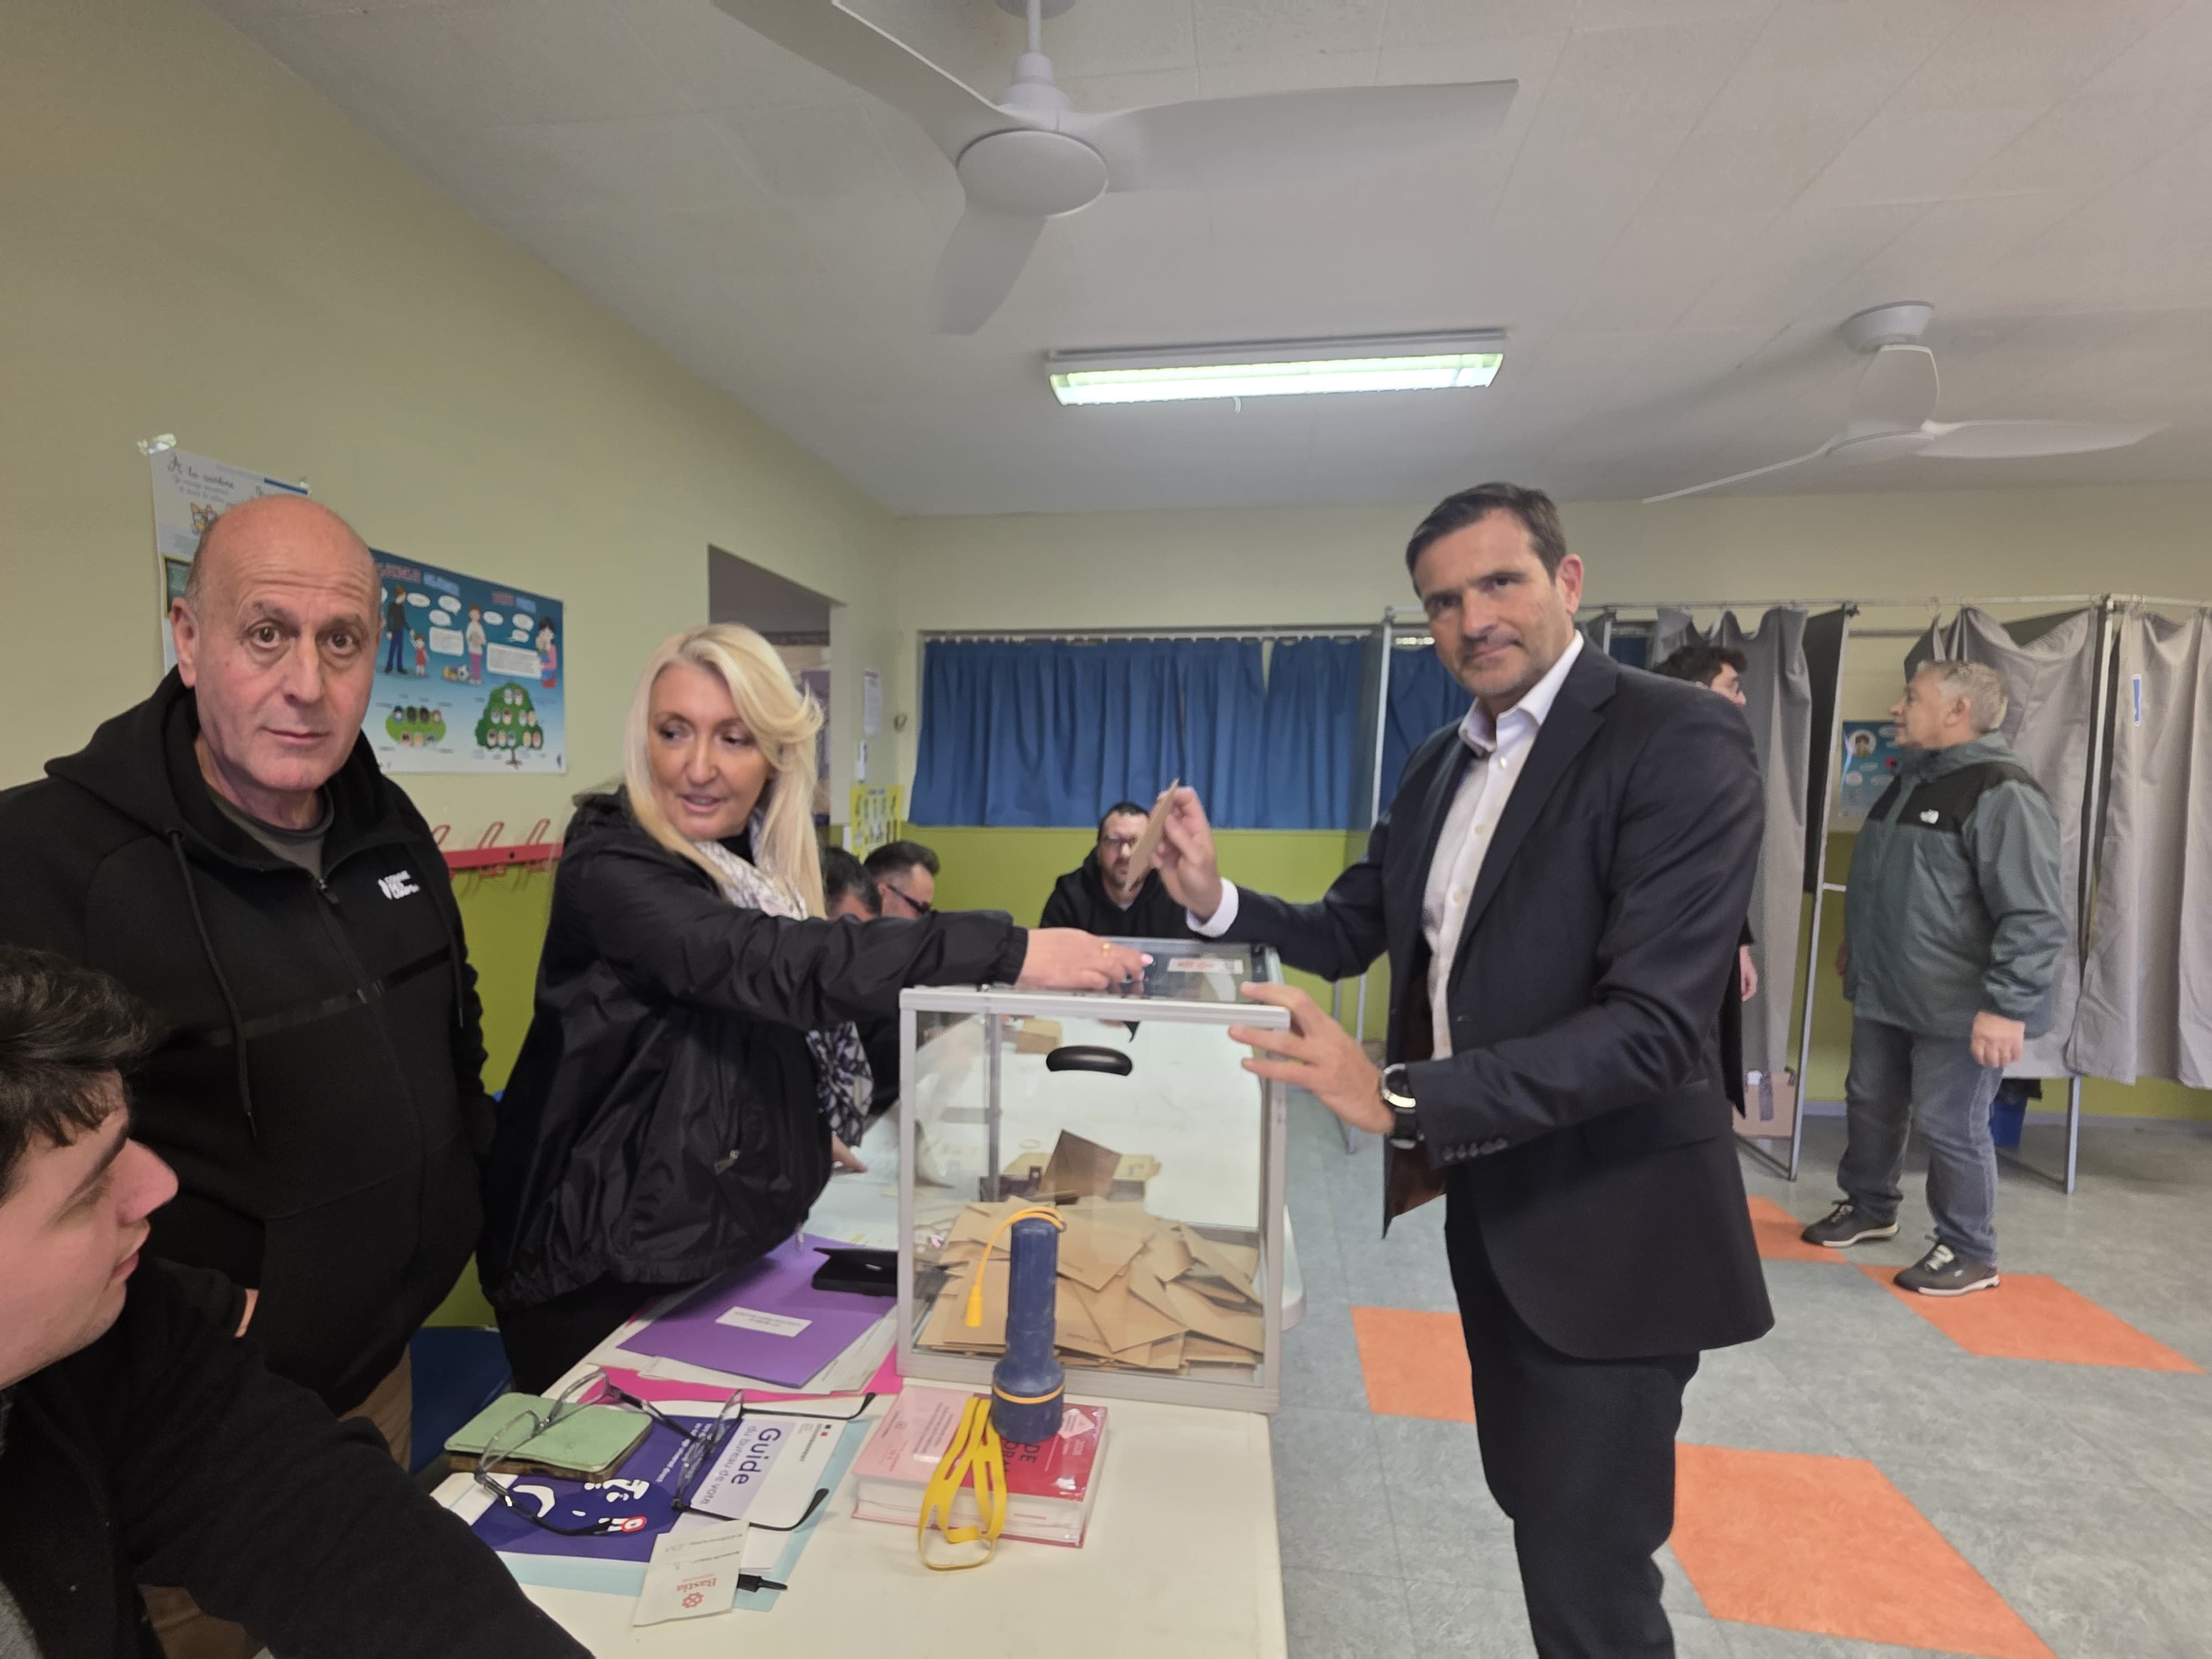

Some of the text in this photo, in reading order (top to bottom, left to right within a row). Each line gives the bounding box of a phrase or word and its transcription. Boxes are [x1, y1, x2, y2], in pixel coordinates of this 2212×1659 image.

[743, 1425, 757, 1437] du
[724, 1438, 752, 1468] bureau
[731, 1428, 780, 1485] Guide
[714, 1469, 729, 1482] de
[676, 1577, 717, 1592] Bastia
